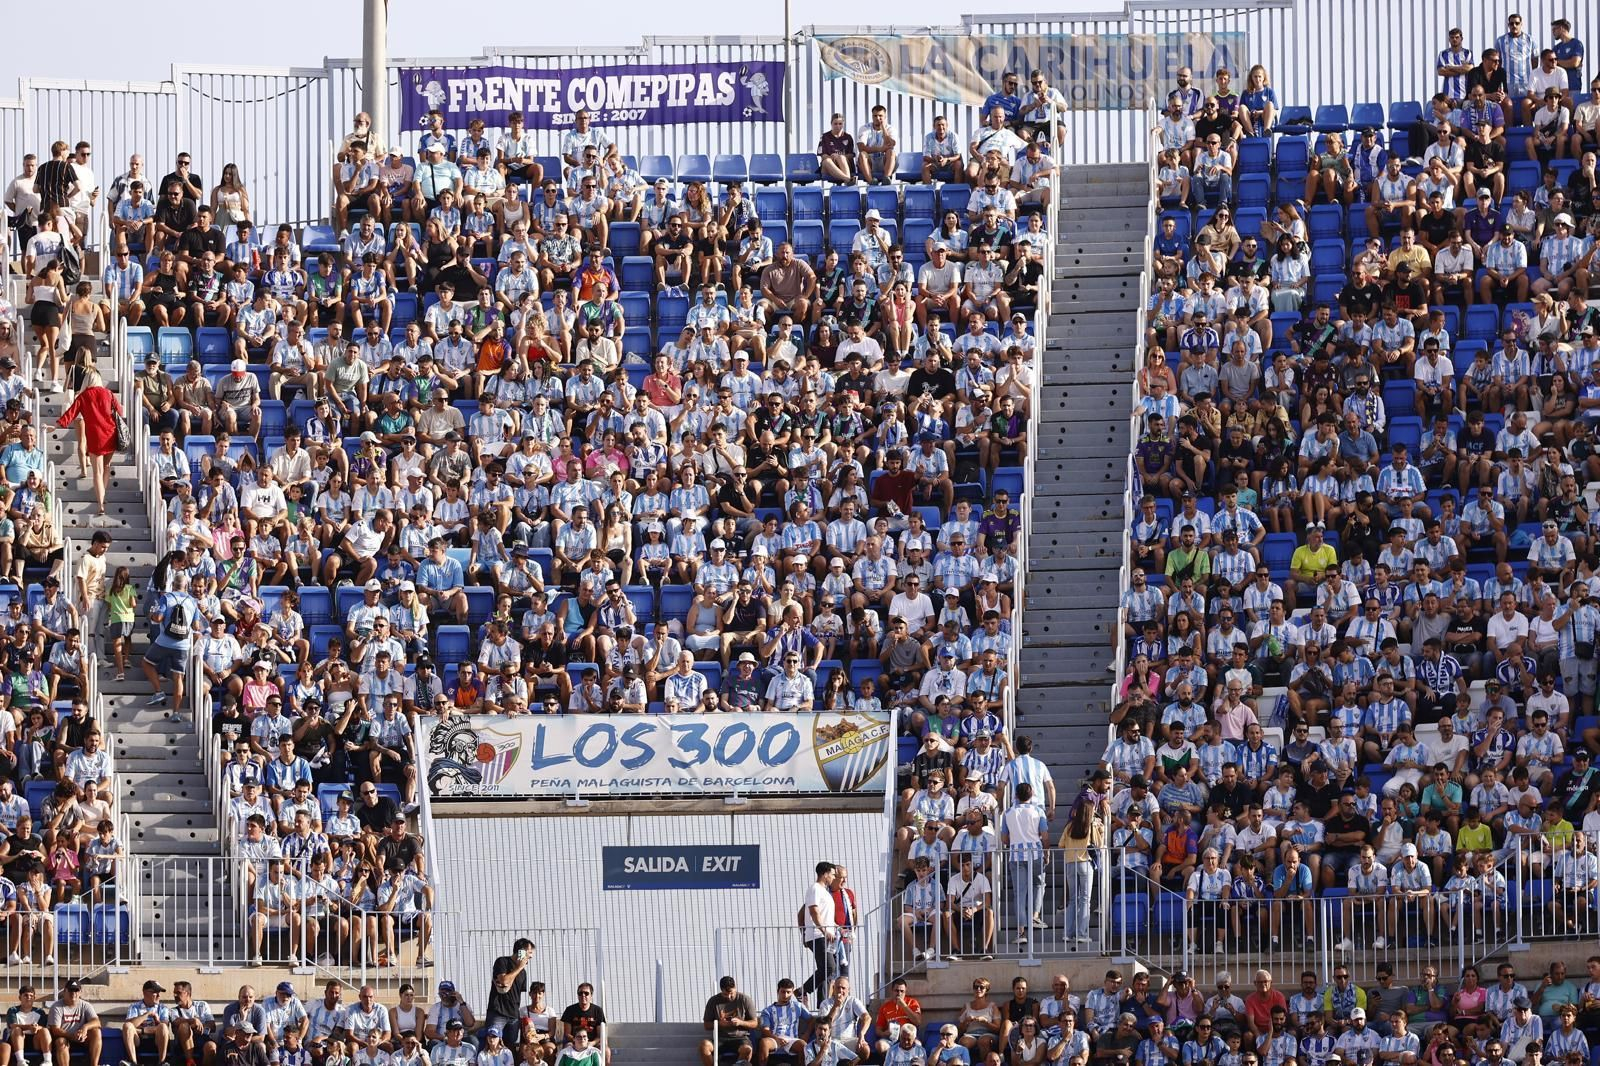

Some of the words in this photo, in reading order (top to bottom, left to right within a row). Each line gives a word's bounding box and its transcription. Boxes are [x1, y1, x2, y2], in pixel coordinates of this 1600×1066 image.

[899, 44, 955, 77] LA
[975, 43, 1240, 80] CARIHUELA
[448, 76, 561, 113] FRENTE
[567, 71, 737, 112] COMEPIPAS
[551, 111, 601, 125] SINE
[610, 109, 647, 122] 2007
[531, 722, 658, 771] LOS
[667, 721, 801, 770] 300
[448, 784, 478, 792] SINCE
[481, 784, 500, 792] 2011
[530, 777, 572, 788] PEÑA
[576, 776, 673, 788] MALAGUISTA
[677, 777, 698, 787] DE
[702, 776, 796, 787] BARCELONA
[623, 856, 690, 874] SALIDA
[702, 855, 742, 872] EXIT
